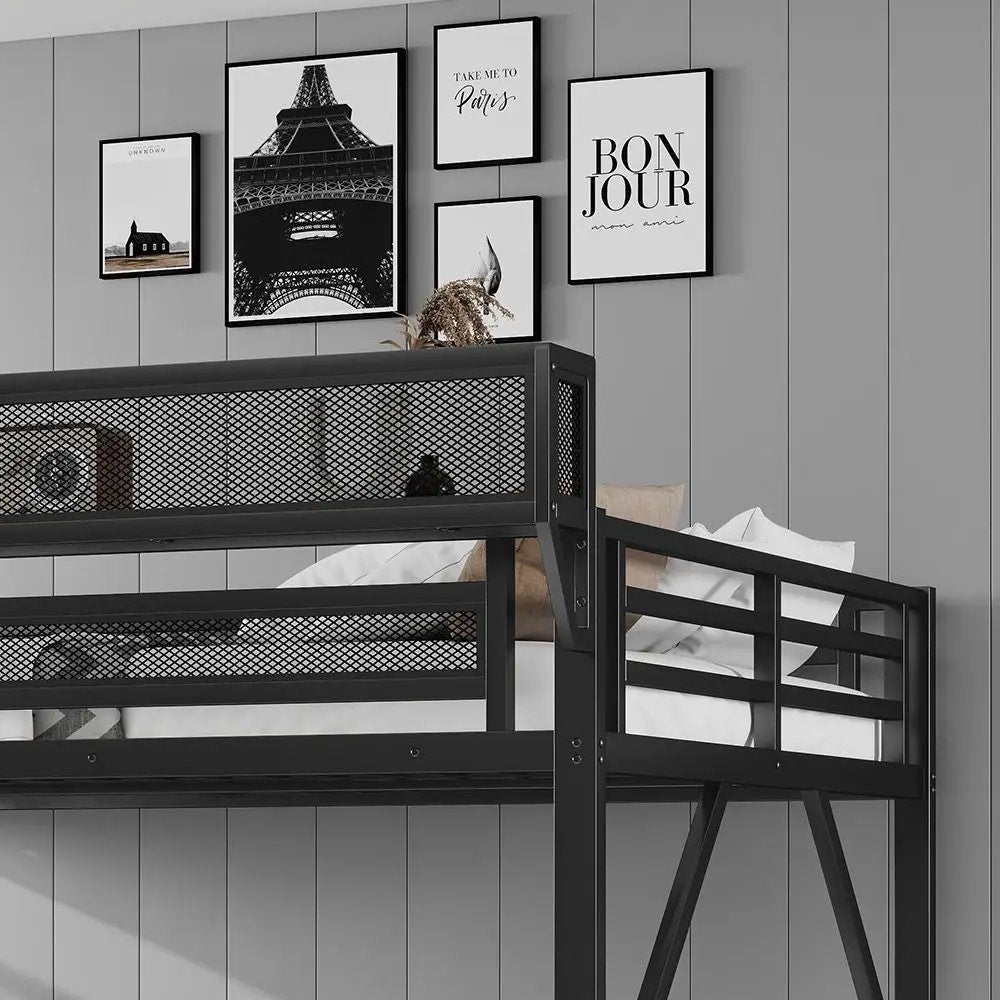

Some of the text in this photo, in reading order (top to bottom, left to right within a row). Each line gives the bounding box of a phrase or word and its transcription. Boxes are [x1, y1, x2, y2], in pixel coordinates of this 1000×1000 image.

[453, 67, 518, 82] TAKE ME TO
[454, 84, 517, 117] Paris
[128, 147, 166, 156] UNKNOWN
[592, 132, 685, 176] BON
[581, 169, 695, 218] JOUR
[643, 215, 685, 227] ami
